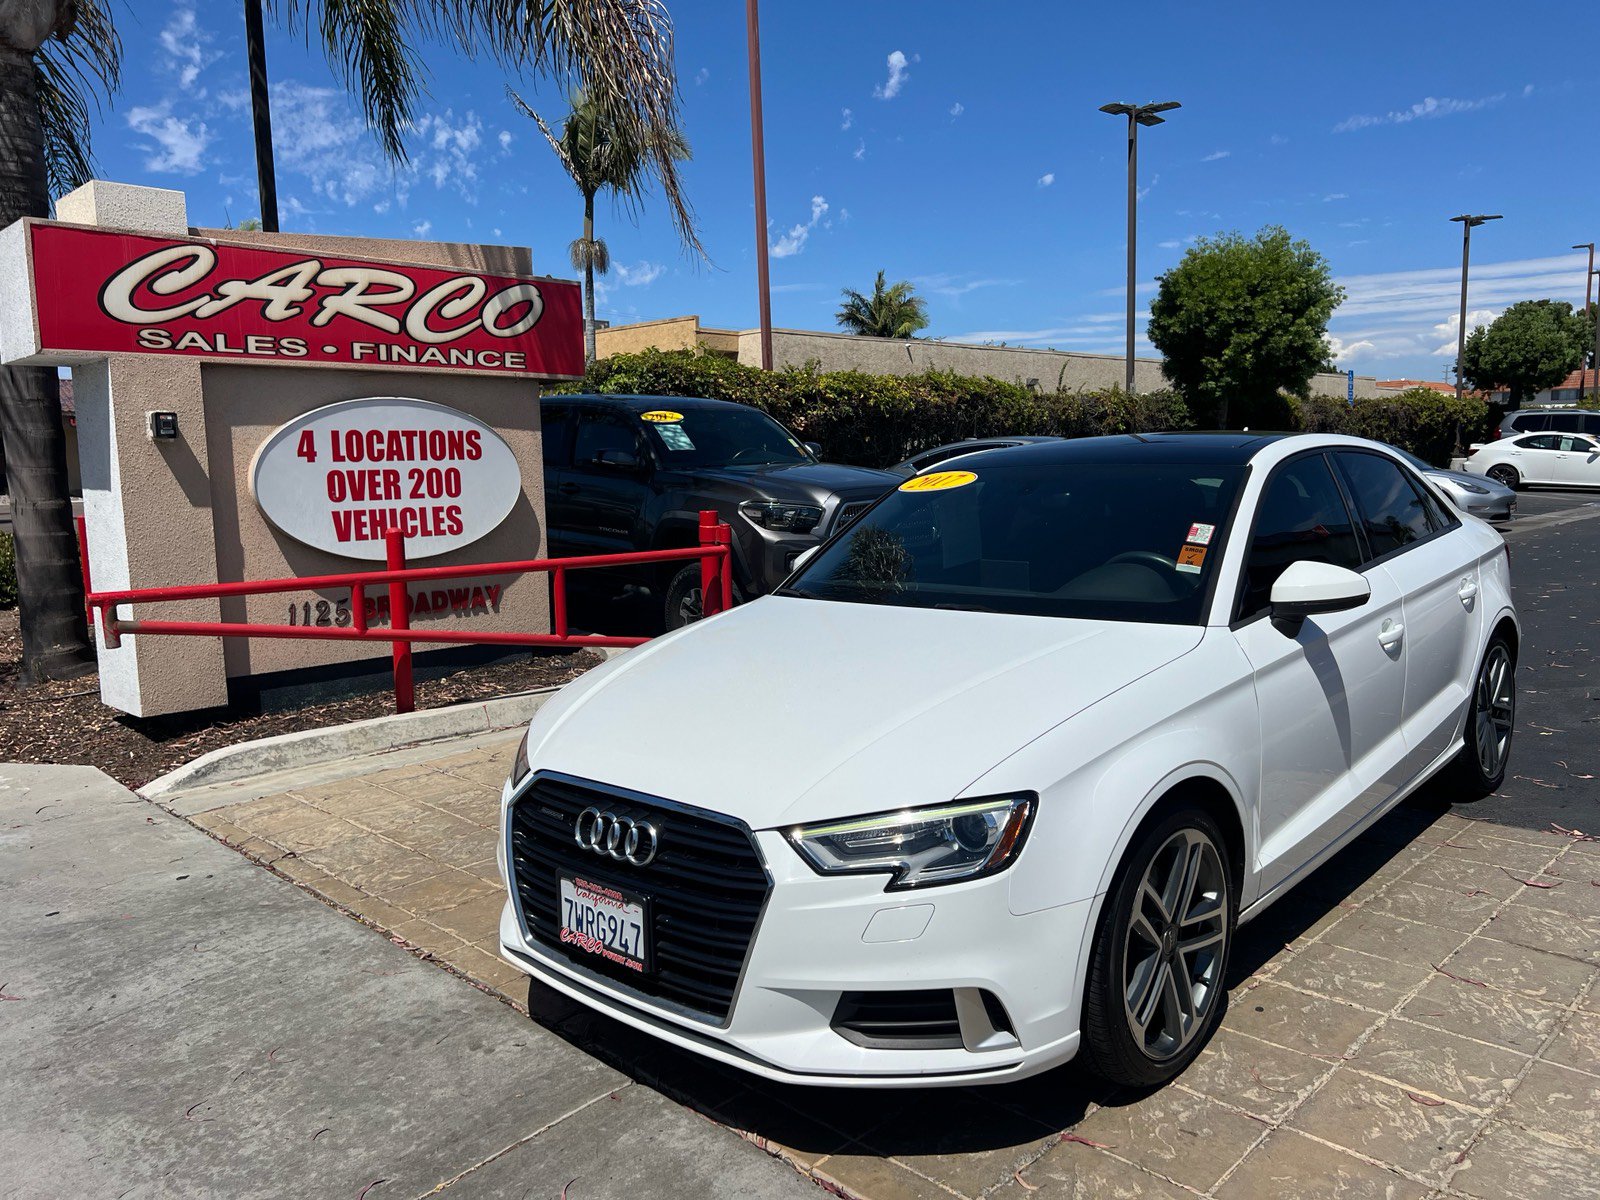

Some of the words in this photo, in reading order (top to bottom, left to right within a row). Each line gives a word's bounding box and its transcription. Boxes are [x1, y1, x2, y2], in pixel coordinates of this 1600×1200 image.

[100, 244, 543, 344] CARCO
[138, 328, 309, 357] SALES
[352, 341, 527, 369] FINANCE
[297, 430, 318, 463] 4
[331, 429, 482, 462] LOCATIONS
[326, 467, 402, 503] OVER
[408, 467, 462, 500] 200
[331, 505, 464, 543] VEHICLES
[288, 597, 351, 627] 1125
[563, 896, 642, 958] 7WRG947
